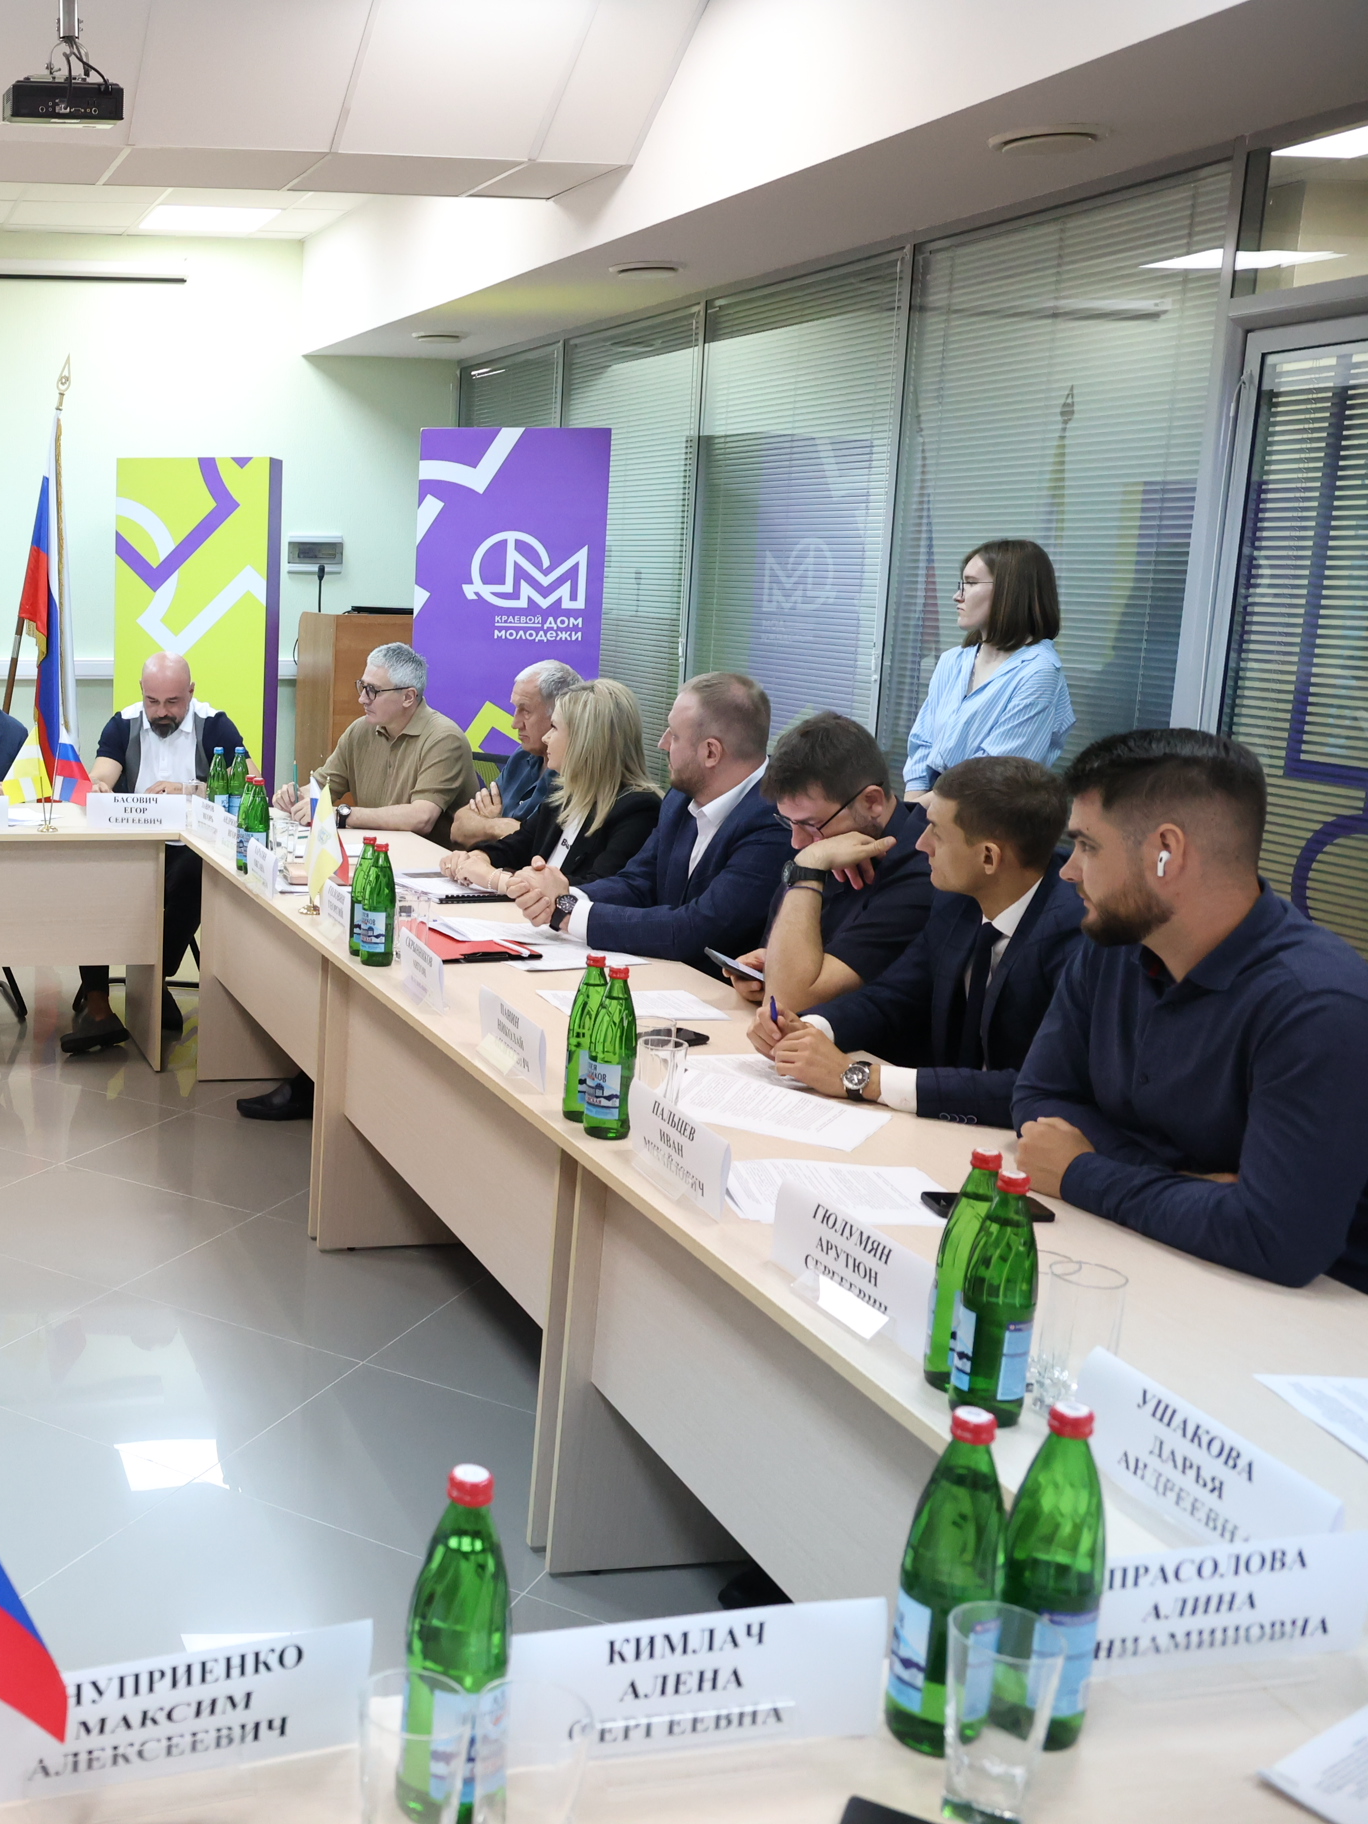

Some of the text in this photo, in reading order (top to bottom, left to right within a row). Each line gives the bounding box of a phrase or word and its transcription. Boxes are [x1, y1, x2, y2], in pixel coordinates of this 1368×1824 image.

[495, 614, 542, 624] КРАЕВОЙ
[108, 816, 163, 825] СЕРГЕЕВИЧ
[113, 796, 158, 804] БАСОВИЧ
[124, 806, 148, 814] ЕГОР
[497, 1018, 525, 1052] НИКОЛАЙ
[651, 1100, 696, 1143] ПАЛЬЦЕВ
[659, 1129, 684, 1158] ИВАН
[812, 1203, 893, 1266] ГЮЛУМЯН
[815, 1236, 879, 1289] АРУТЮН
[1137, 1388, 1256, 1485] УШАКОВА
[1149, 1435, 1225, 1502] ДАРЬЯ
[1117, 1450, 1251, 1543] АНДРЕЕВН
[1107, 1547, 1308, 1592] ПРАСОЛОВА
[1141, 1591, 1257, 1623] АЛИНА
[607, 1620, 768, 1667] КИМЛАЧ
[1093, 1616, 1330, 1661] НИАМИНОВНА
[618, 1667, 744, 1703] АЛЕНА
[74, 1690, 254, 1742] МАКСИМ
[568, 1700, 785, 1745] СЕРГЕЕВНА
[27, 1715, 290, 1782] АЛЕКСЕЕВИЧ
